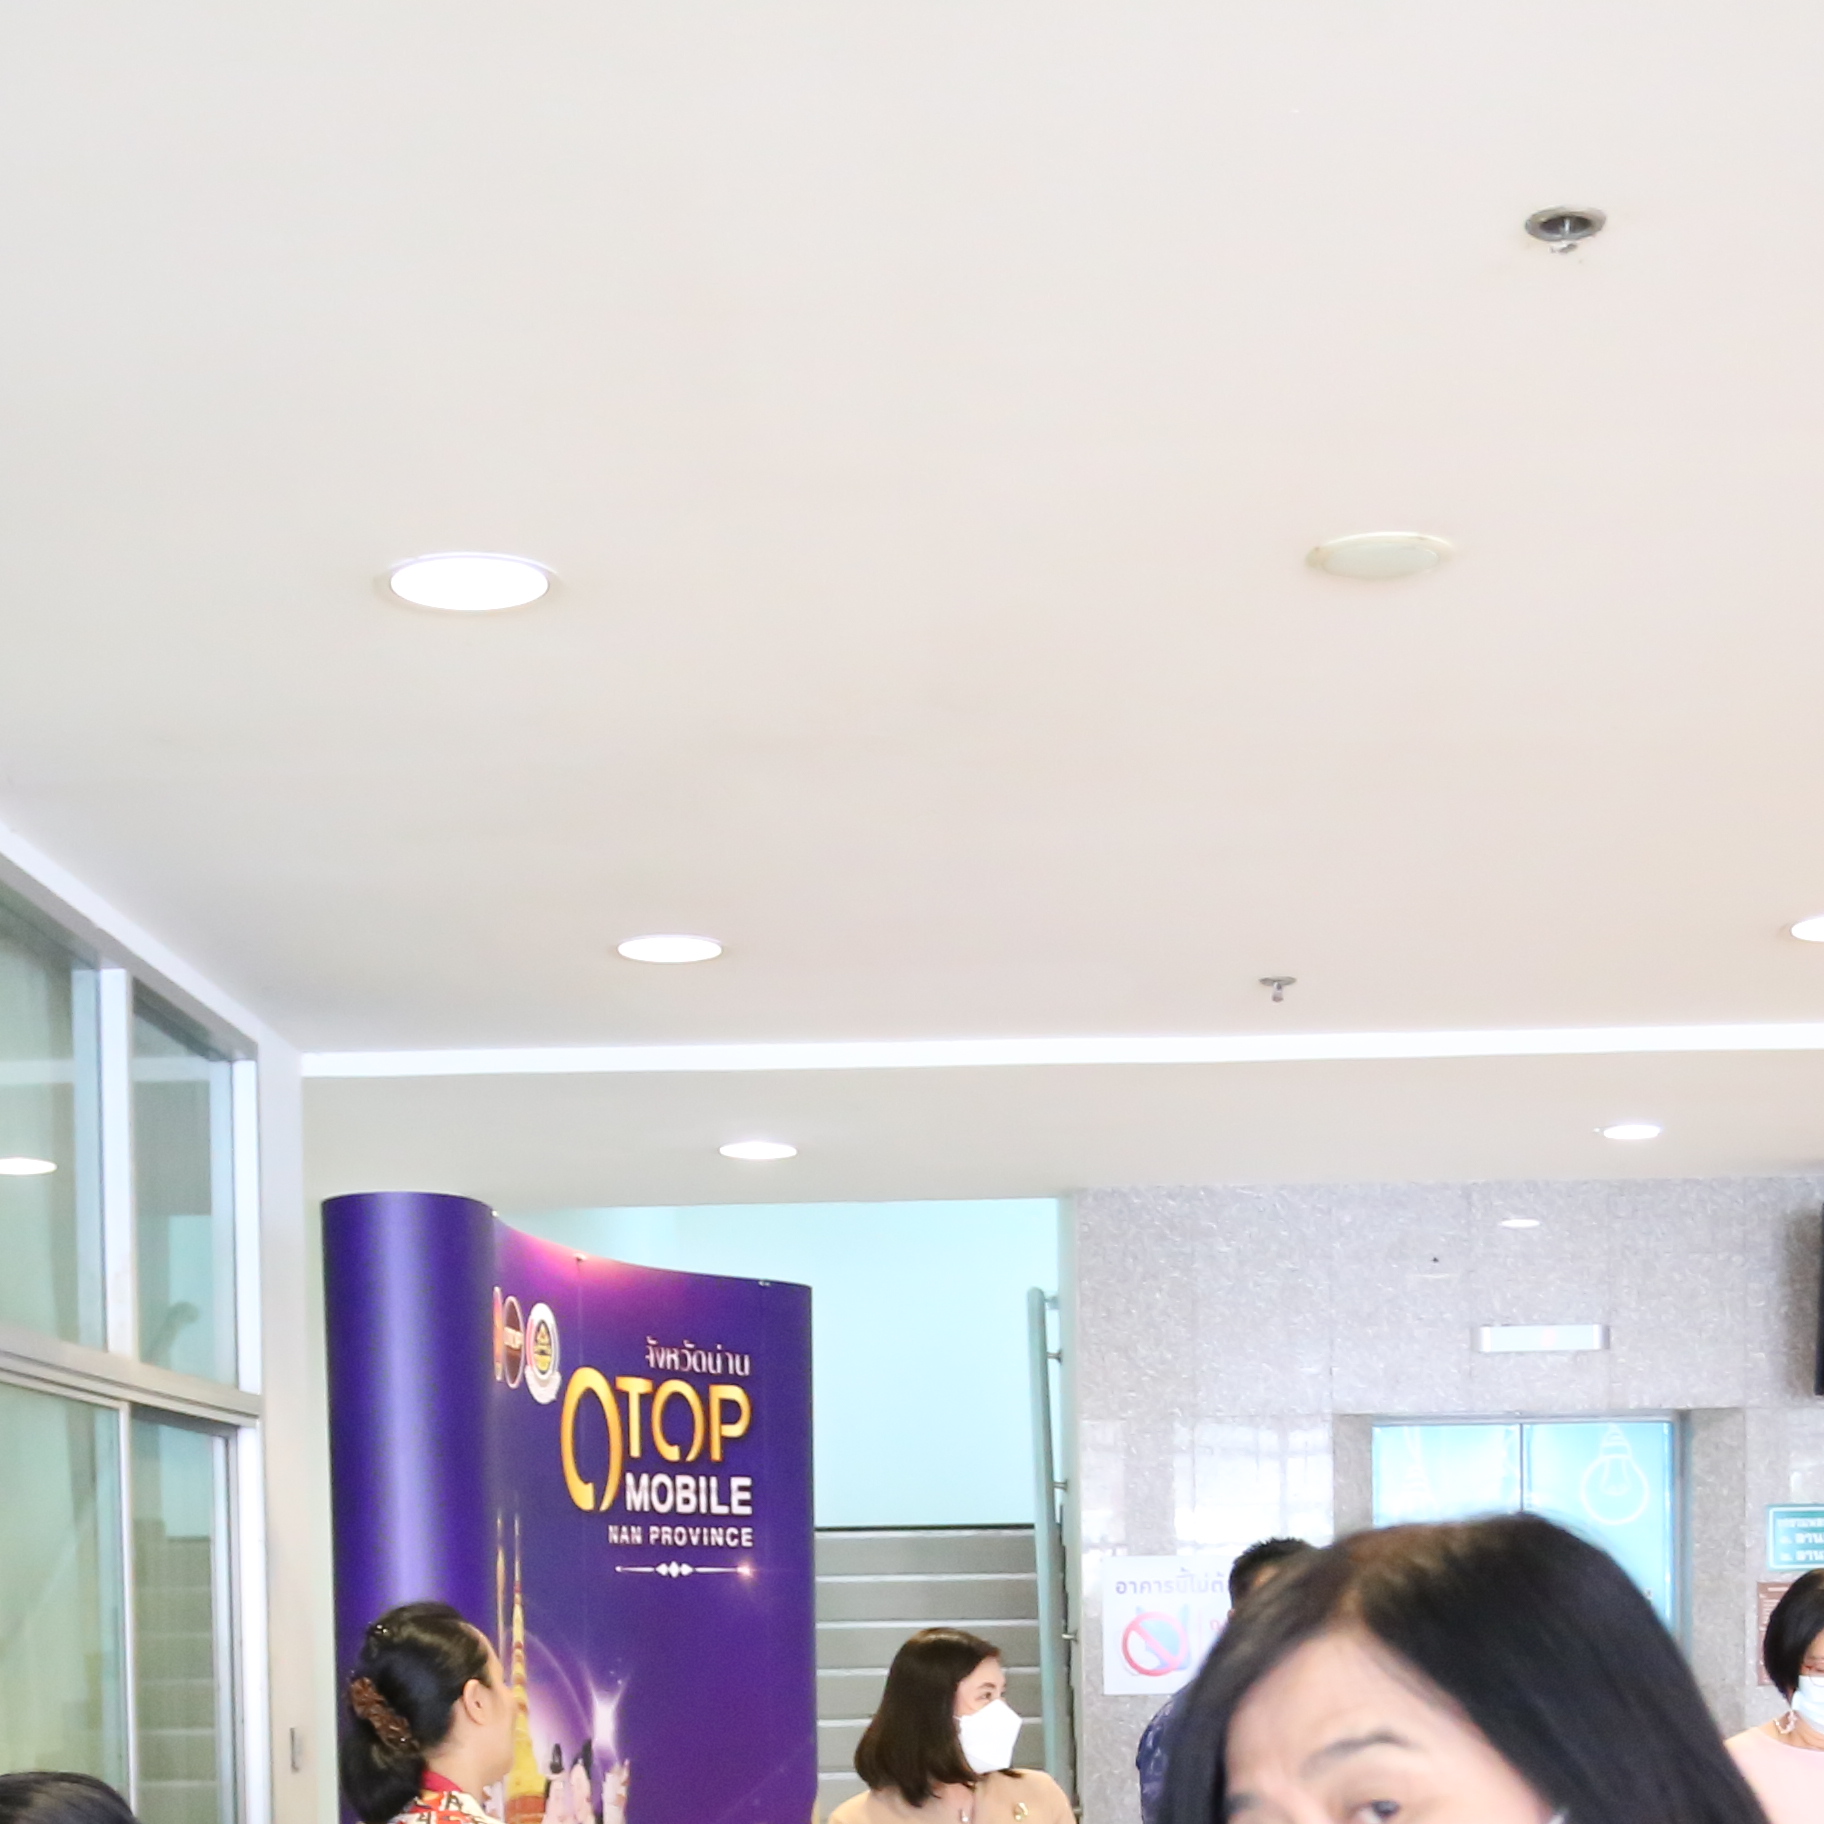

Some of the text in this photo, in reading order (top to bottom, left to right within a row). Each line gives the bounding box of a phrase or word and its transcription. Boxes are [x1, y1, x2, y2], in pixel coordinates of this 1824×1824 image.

[645, 1335, 750, 1376] จังหวัดน่าน
[561, 1366, 753, 1512] OTOP
[625, 1473, 753, 1515] MOBILE
[608, 1524, 754, 1548] NAN PROVINCE
[1115, 1567, 1225, 1595] อาคารนี้ไม่ต้
